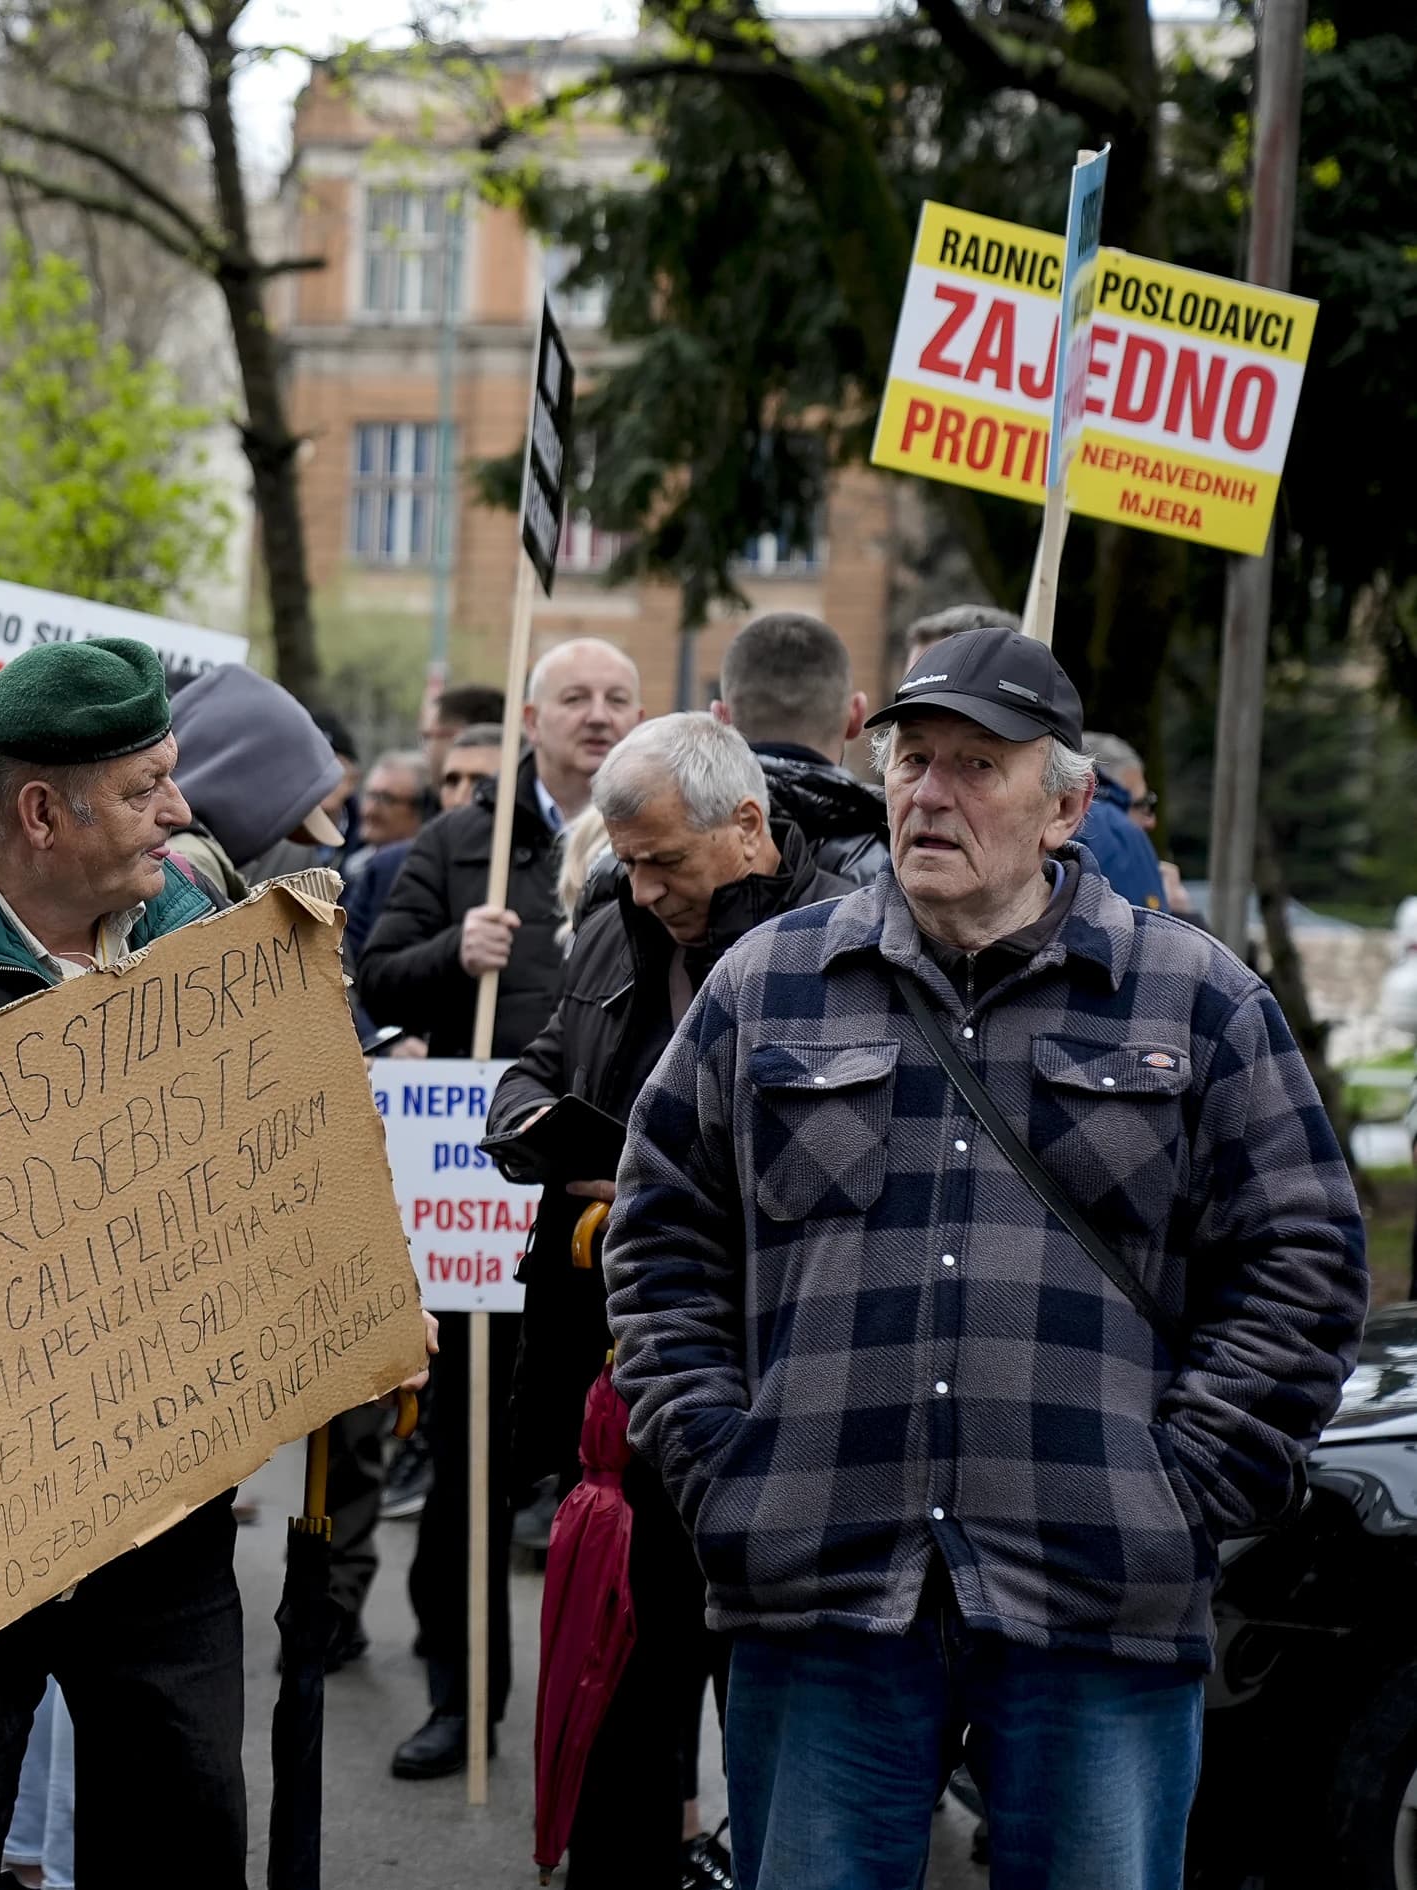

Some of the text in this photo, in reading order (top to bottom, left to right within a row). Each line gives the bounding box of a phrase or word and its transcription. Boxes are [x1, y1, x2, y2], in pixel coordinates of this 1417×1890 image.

[938, 226, 1062, 294] RADNIC
[1097, 268, 1295, 352] POSLODAVCI
[899, 397, 1257, 507] PROTI NEPRAVEDNIH
[1117, 488, 1203, 530] MJERA
[433, 1141, 498, 1173] pos
[413, 1198, 541, 1232] POSTAJ
[427, 1250, 503, 1288] tvoja
